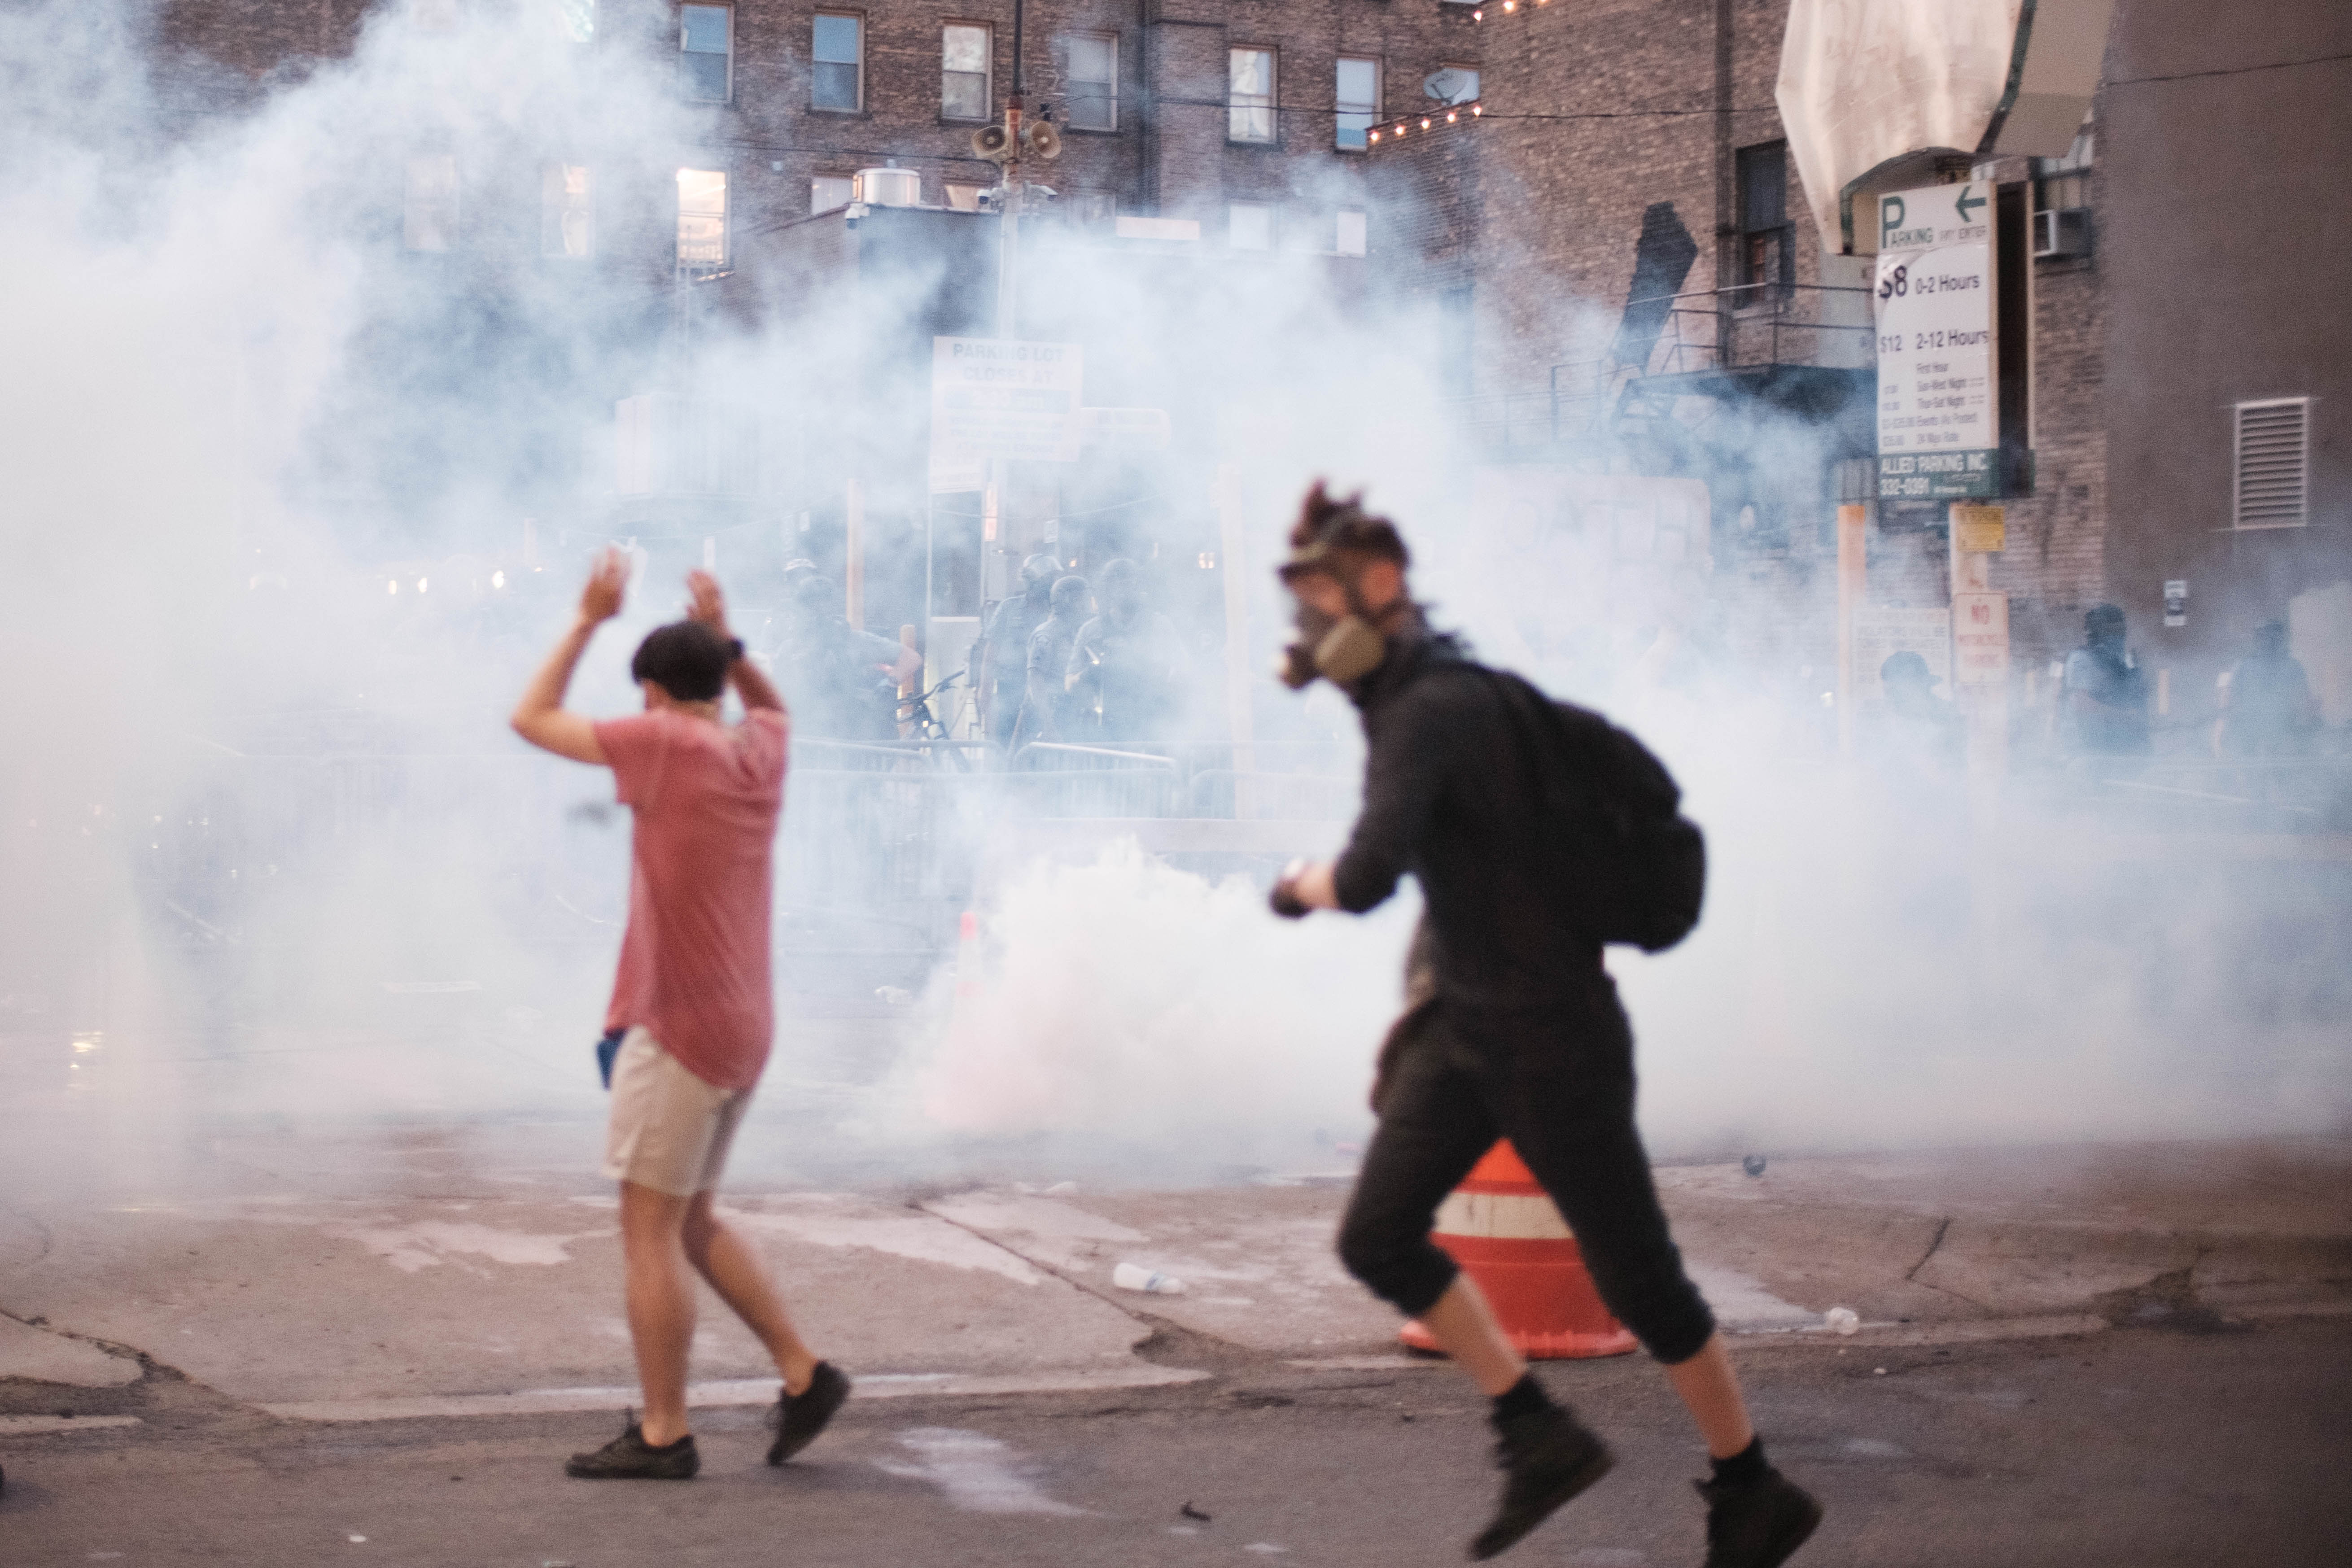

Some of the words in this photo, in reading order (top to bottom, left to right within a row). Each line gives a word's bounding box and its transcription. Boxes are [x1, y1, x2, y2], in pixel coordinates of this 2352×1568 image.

[1915, 276, 1935, 295] 0-2
[1939, 274, 1980, 292] Hours
[1916, 330, 1944, 349] 2-12
[1948, 329, 1989, 346] Hours
[953, 342, 1027, 361] PARKING
[1034, 347, 1066, 363] LOT
[962, 367, 1027, 383] CLOSES
[1032, 370, 1054, 384] AT
[1917, 454, 1964, 472] PARKING
